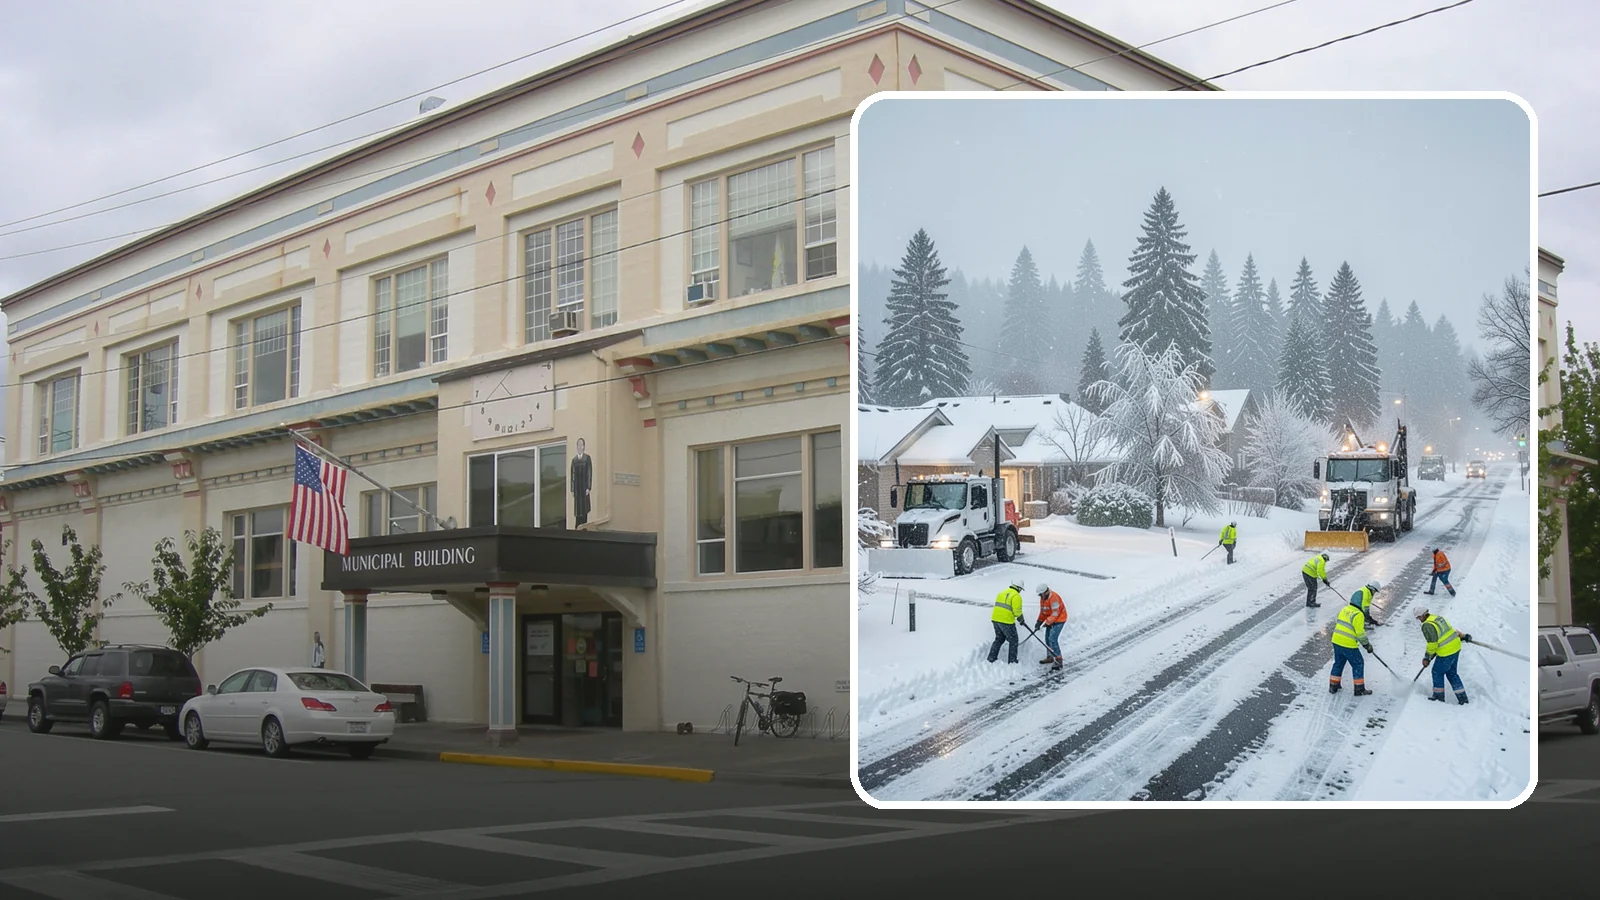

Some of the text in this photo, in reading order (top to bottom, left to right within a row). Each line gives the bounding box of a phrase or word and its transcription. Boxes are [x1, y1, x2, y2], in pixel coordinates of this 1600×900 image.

[475, 390, 479, 398] 7
[480, 407, 484, 415] 8
[488, 418, 492, 426] 9
[494, 424, 500, 432] 10
[528, 414, 533, 422] 3
[342, 546, 475, 572] MUNICIPAL BUILDING
